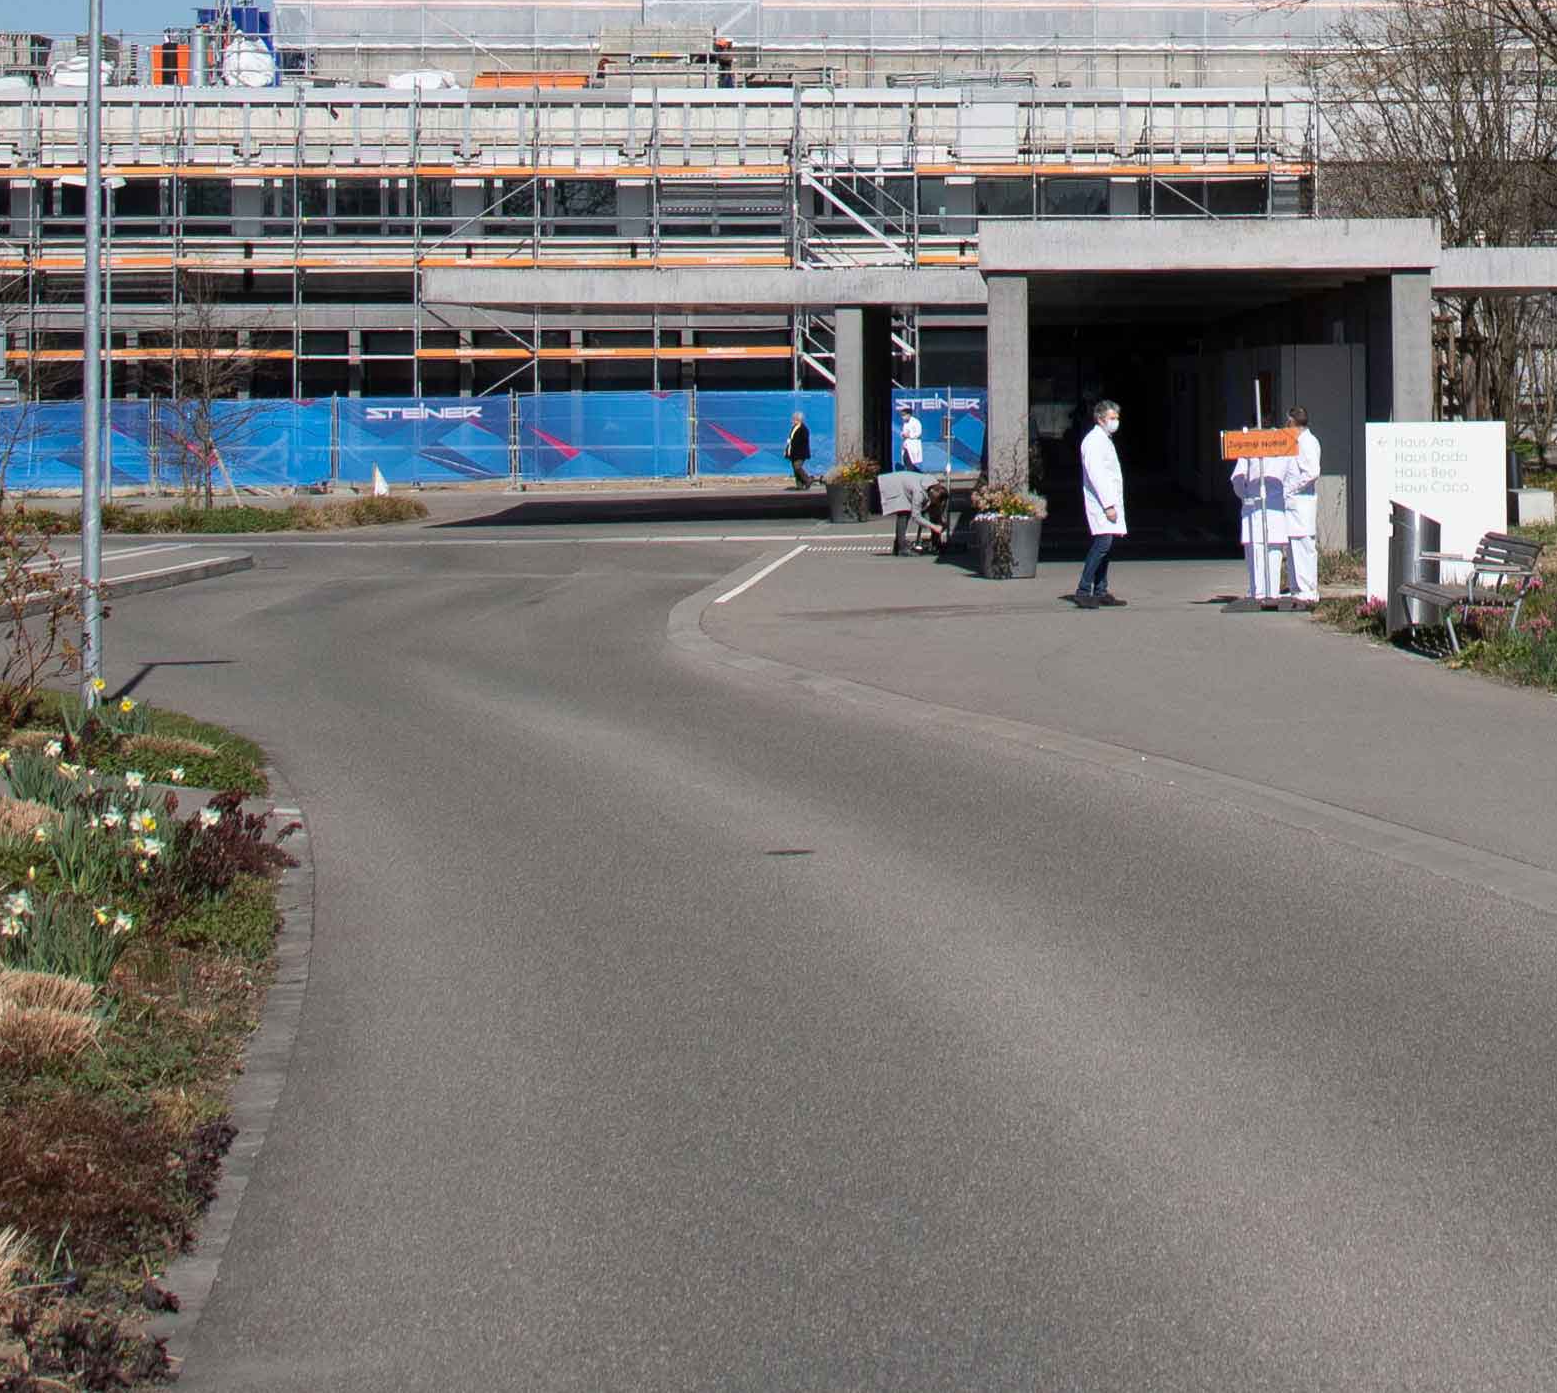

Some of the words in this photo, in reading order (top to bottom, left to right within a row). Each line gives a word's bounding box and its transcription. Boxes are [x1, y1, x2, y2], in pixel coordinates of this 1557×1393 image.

[895, 393, 981, 410] STEINER
[365, 402, 483, 420] STEINER
[1395, 437, 1427, 448] Haus
[1395, 451, 1427, 462] Haus
[1395, 467, 1427, 478] Haus
[1395, 482, 1427, 493] Haus
